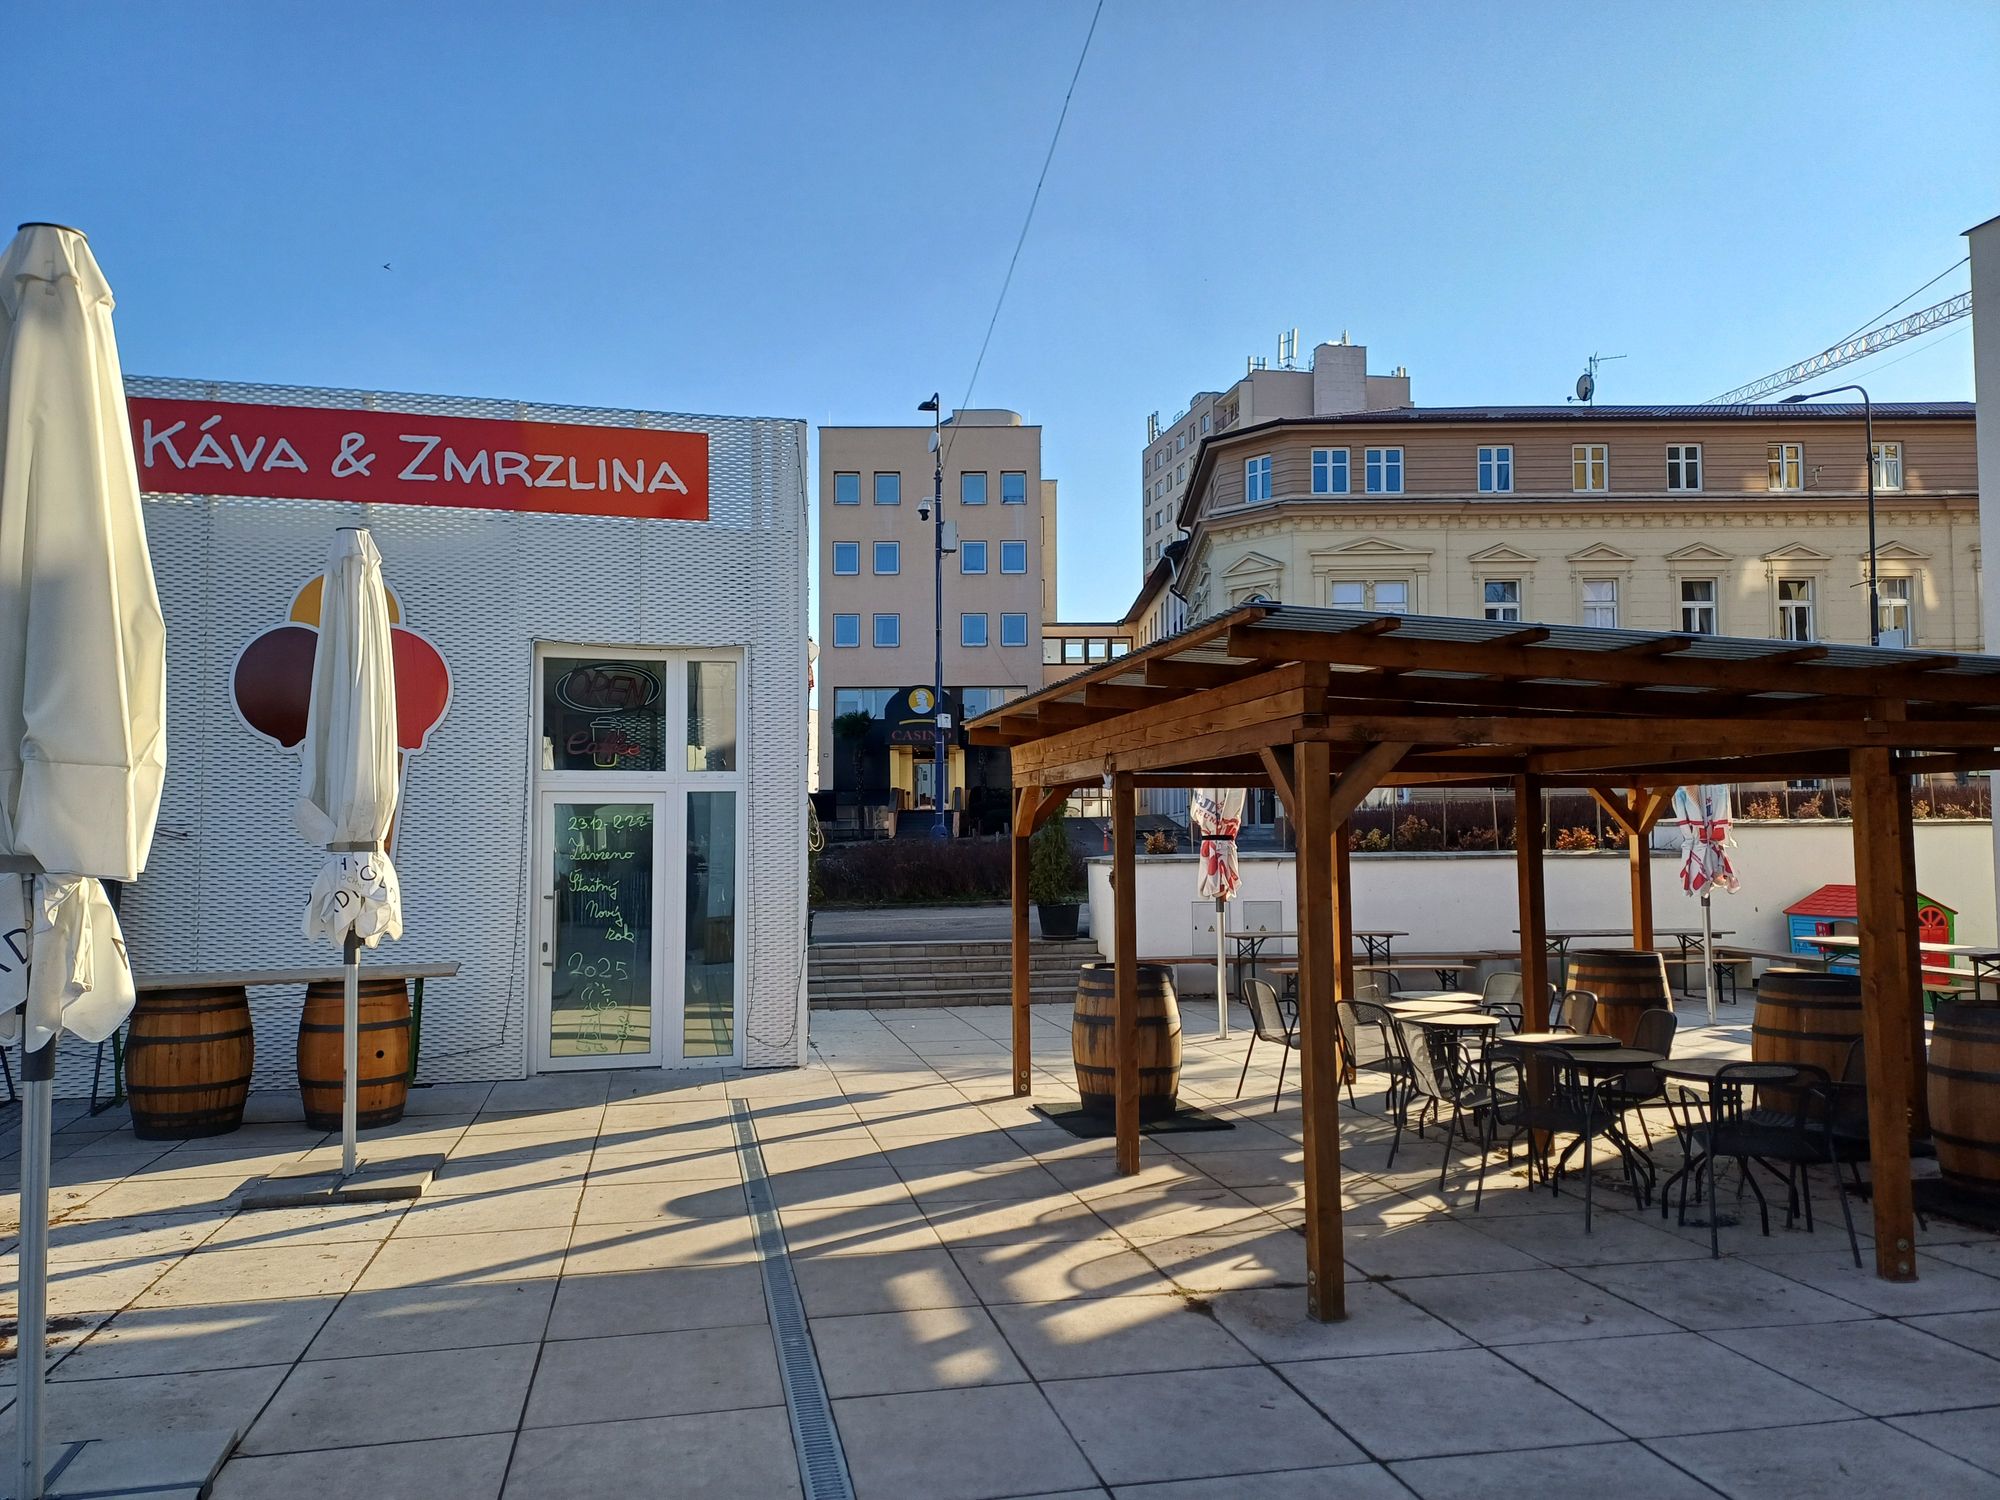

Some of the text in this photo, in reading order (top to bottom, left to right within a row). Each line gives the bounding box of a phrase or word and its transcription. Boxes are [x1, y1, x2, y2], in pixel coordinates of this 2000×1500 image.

[143, 415, 689, 495] KÁVA & ZMRZLINA
[569, 669, 646, 705] OPEN
[891, 730, 952, 740] CASIN
[585, 900, 624, 928] Nový
[568, 952, 628, 981] 2025
